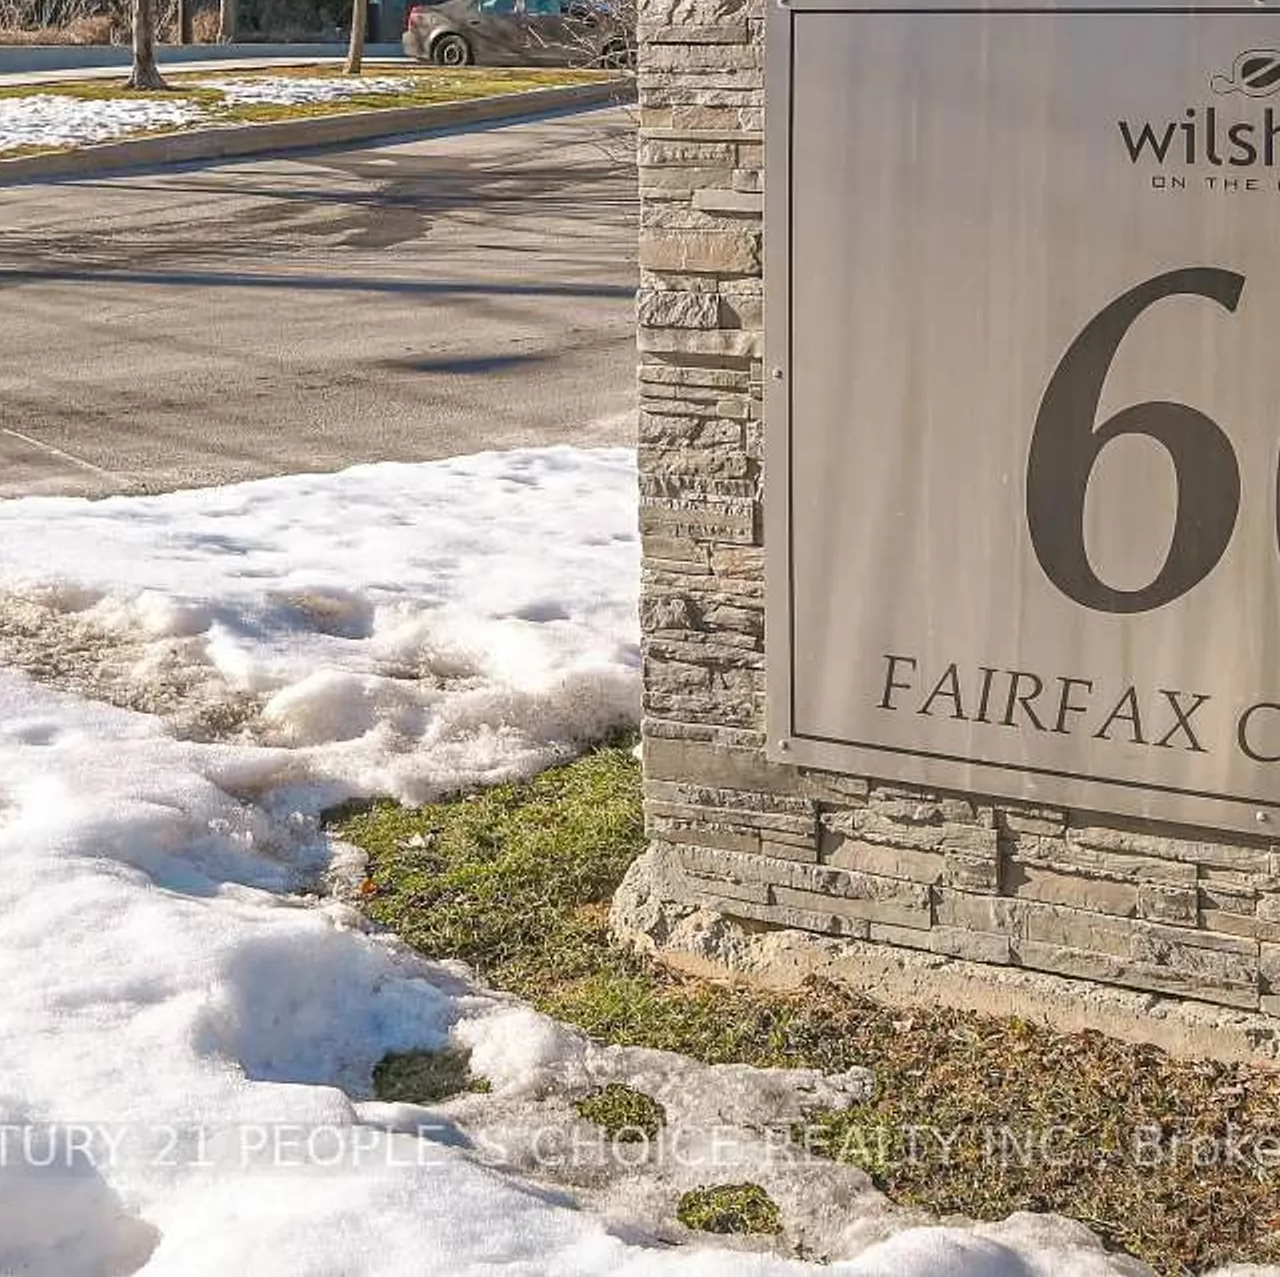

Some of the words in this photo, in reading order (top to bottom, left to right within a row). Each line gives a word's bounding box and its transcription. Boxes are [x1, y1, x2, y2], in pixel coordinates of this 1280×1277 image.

[1152, 176, 1186, 190] ON
[1206, 176, 1260, 192] THE
[875, 654, 1212, 752] FAIRFAX
